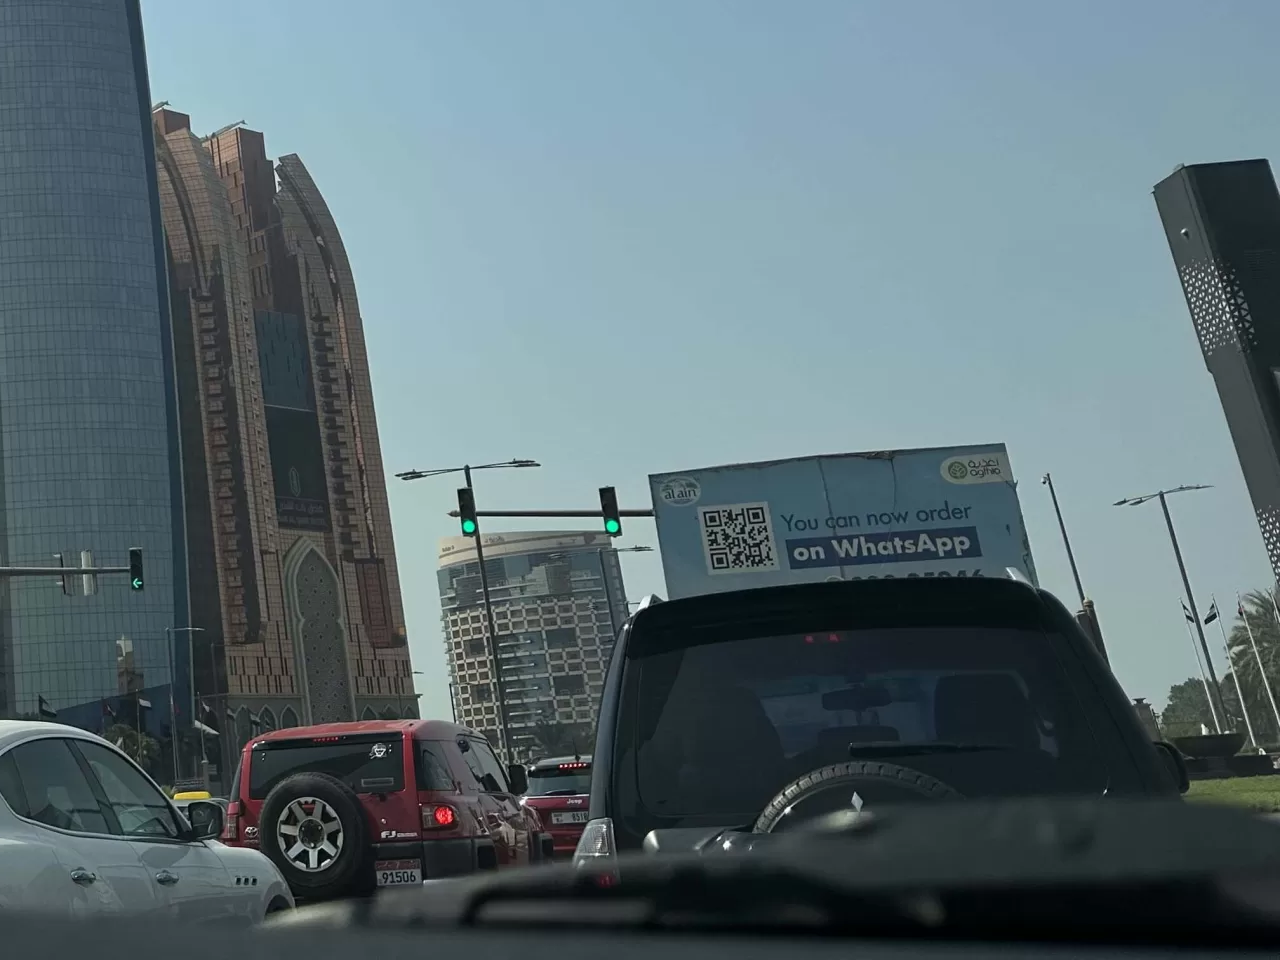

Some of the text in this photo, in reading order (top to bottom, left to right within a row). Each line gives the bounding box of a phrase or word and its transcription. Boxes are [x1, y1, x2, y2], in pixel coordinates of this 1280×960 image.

[665, 487, 697, 500] al ain
[780, 500, 973, 532] You can now order
[793, 533, 971, 561] on WhatsApp
[380, 830, 397, 839] FJ
[382, 871, 416, 884] 91506
